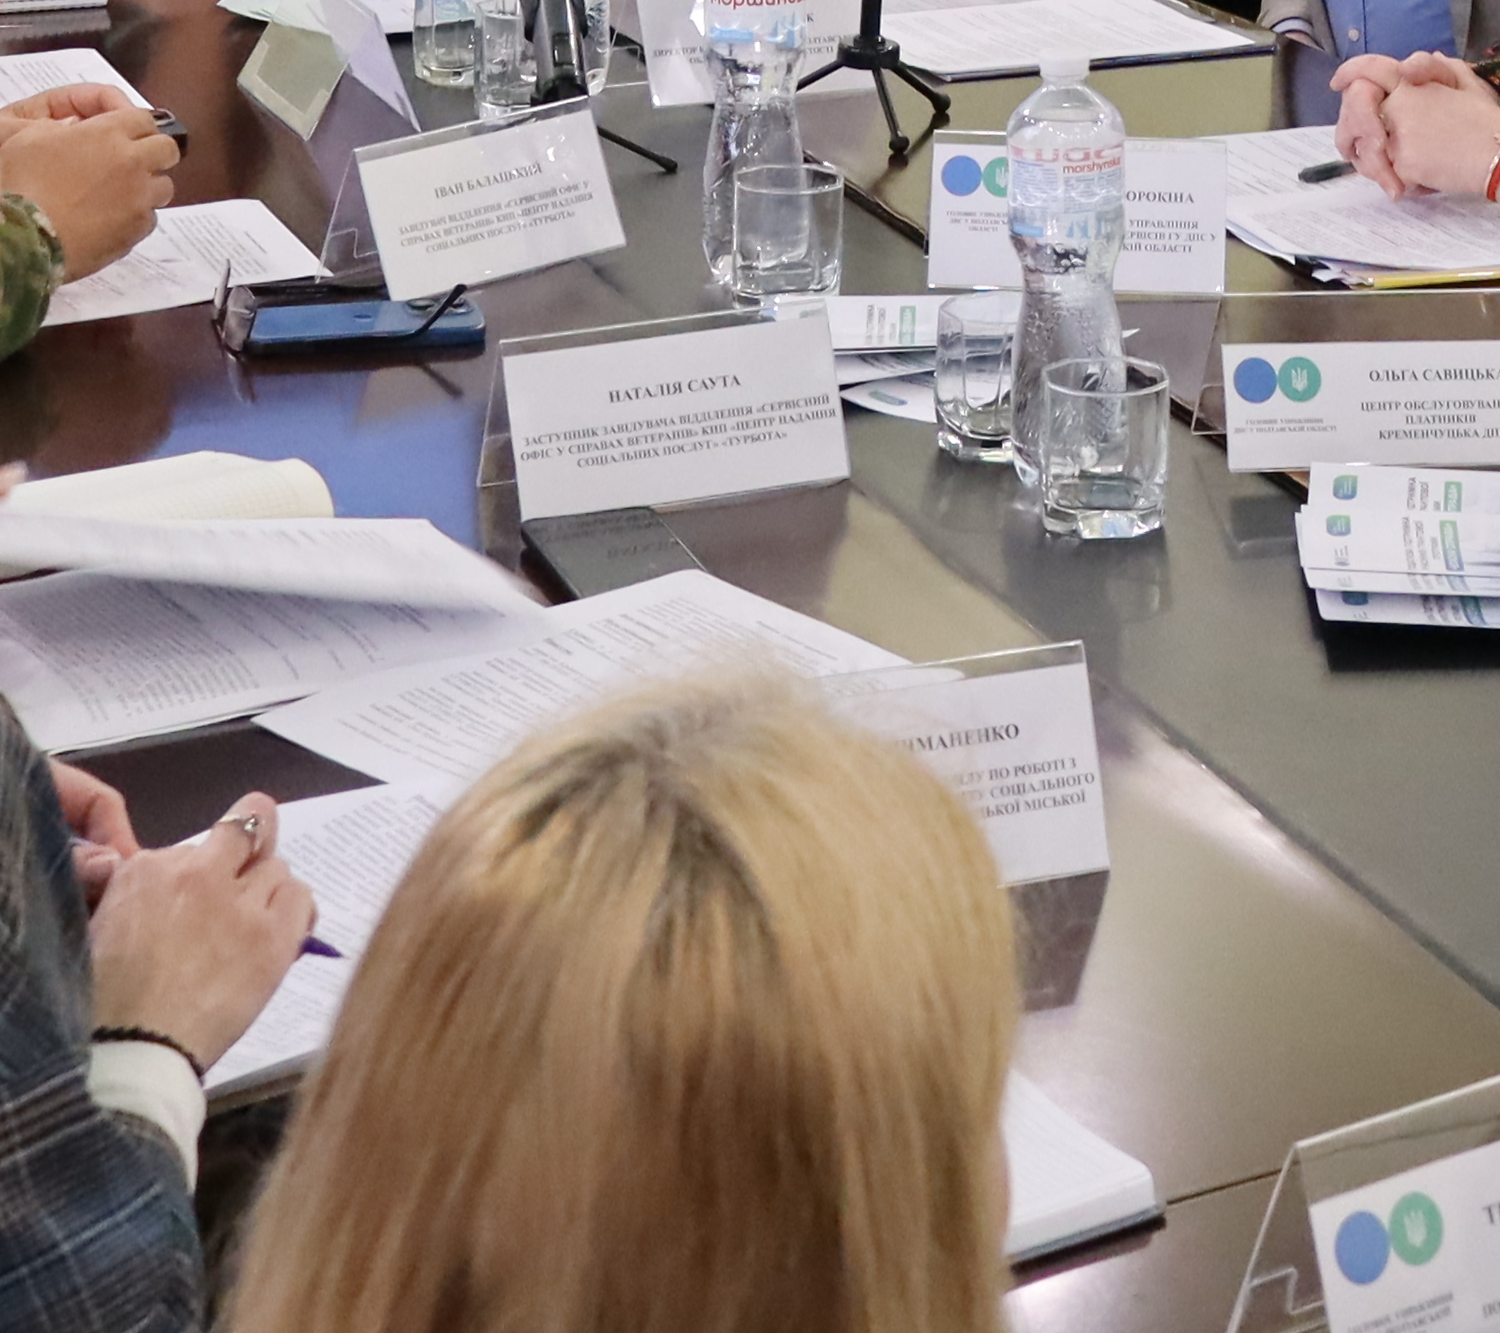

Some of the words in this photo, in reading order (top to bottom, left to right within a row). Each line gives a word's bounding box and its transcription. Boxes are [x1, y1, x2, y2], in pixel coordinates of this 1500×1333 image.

[434, 182, 464, 199] ІВАН
[1125, 191, 1195, 204] ОРОКІНА
[1369, 369, 1419, 382] ОЛЬГА
[608, 381, 683, 404] НАТАЛІЯ
[687, 374, 741, 393] САУТА
[1360, 400, 1400, 412] ЦЕНТР
[524, 427, 599, 446] ЗАСТУПНИК
[602, 417, 676, 437] ЗАВІДУВАЧА
[679, 406, 753, 426] ВІДДІЛЕННЯ
[1405, 414, 1476, 425] ПЛАТНИКІВ
[520, 447, 554, 462] ОФІС
[557, 444, 566, 457] У
[568, 437, 624, 456] СПРАВАХ
[778, 408, 836, 427] НАДАННЯ
[1379, 429, 1480, 440] КРЕМЕНЧУЦЬКА
[576, 448, 660, 469] СОЦІАЛЬНИХ
[989, 768, 1010, 781] ПО
[1014, 758, 1066, 778] РОБОТІ
[990, 773, 1095, 799] СОЦІАЛЬНОГО
[1024, 790, 1086, 812] МІСЬКОЇ
